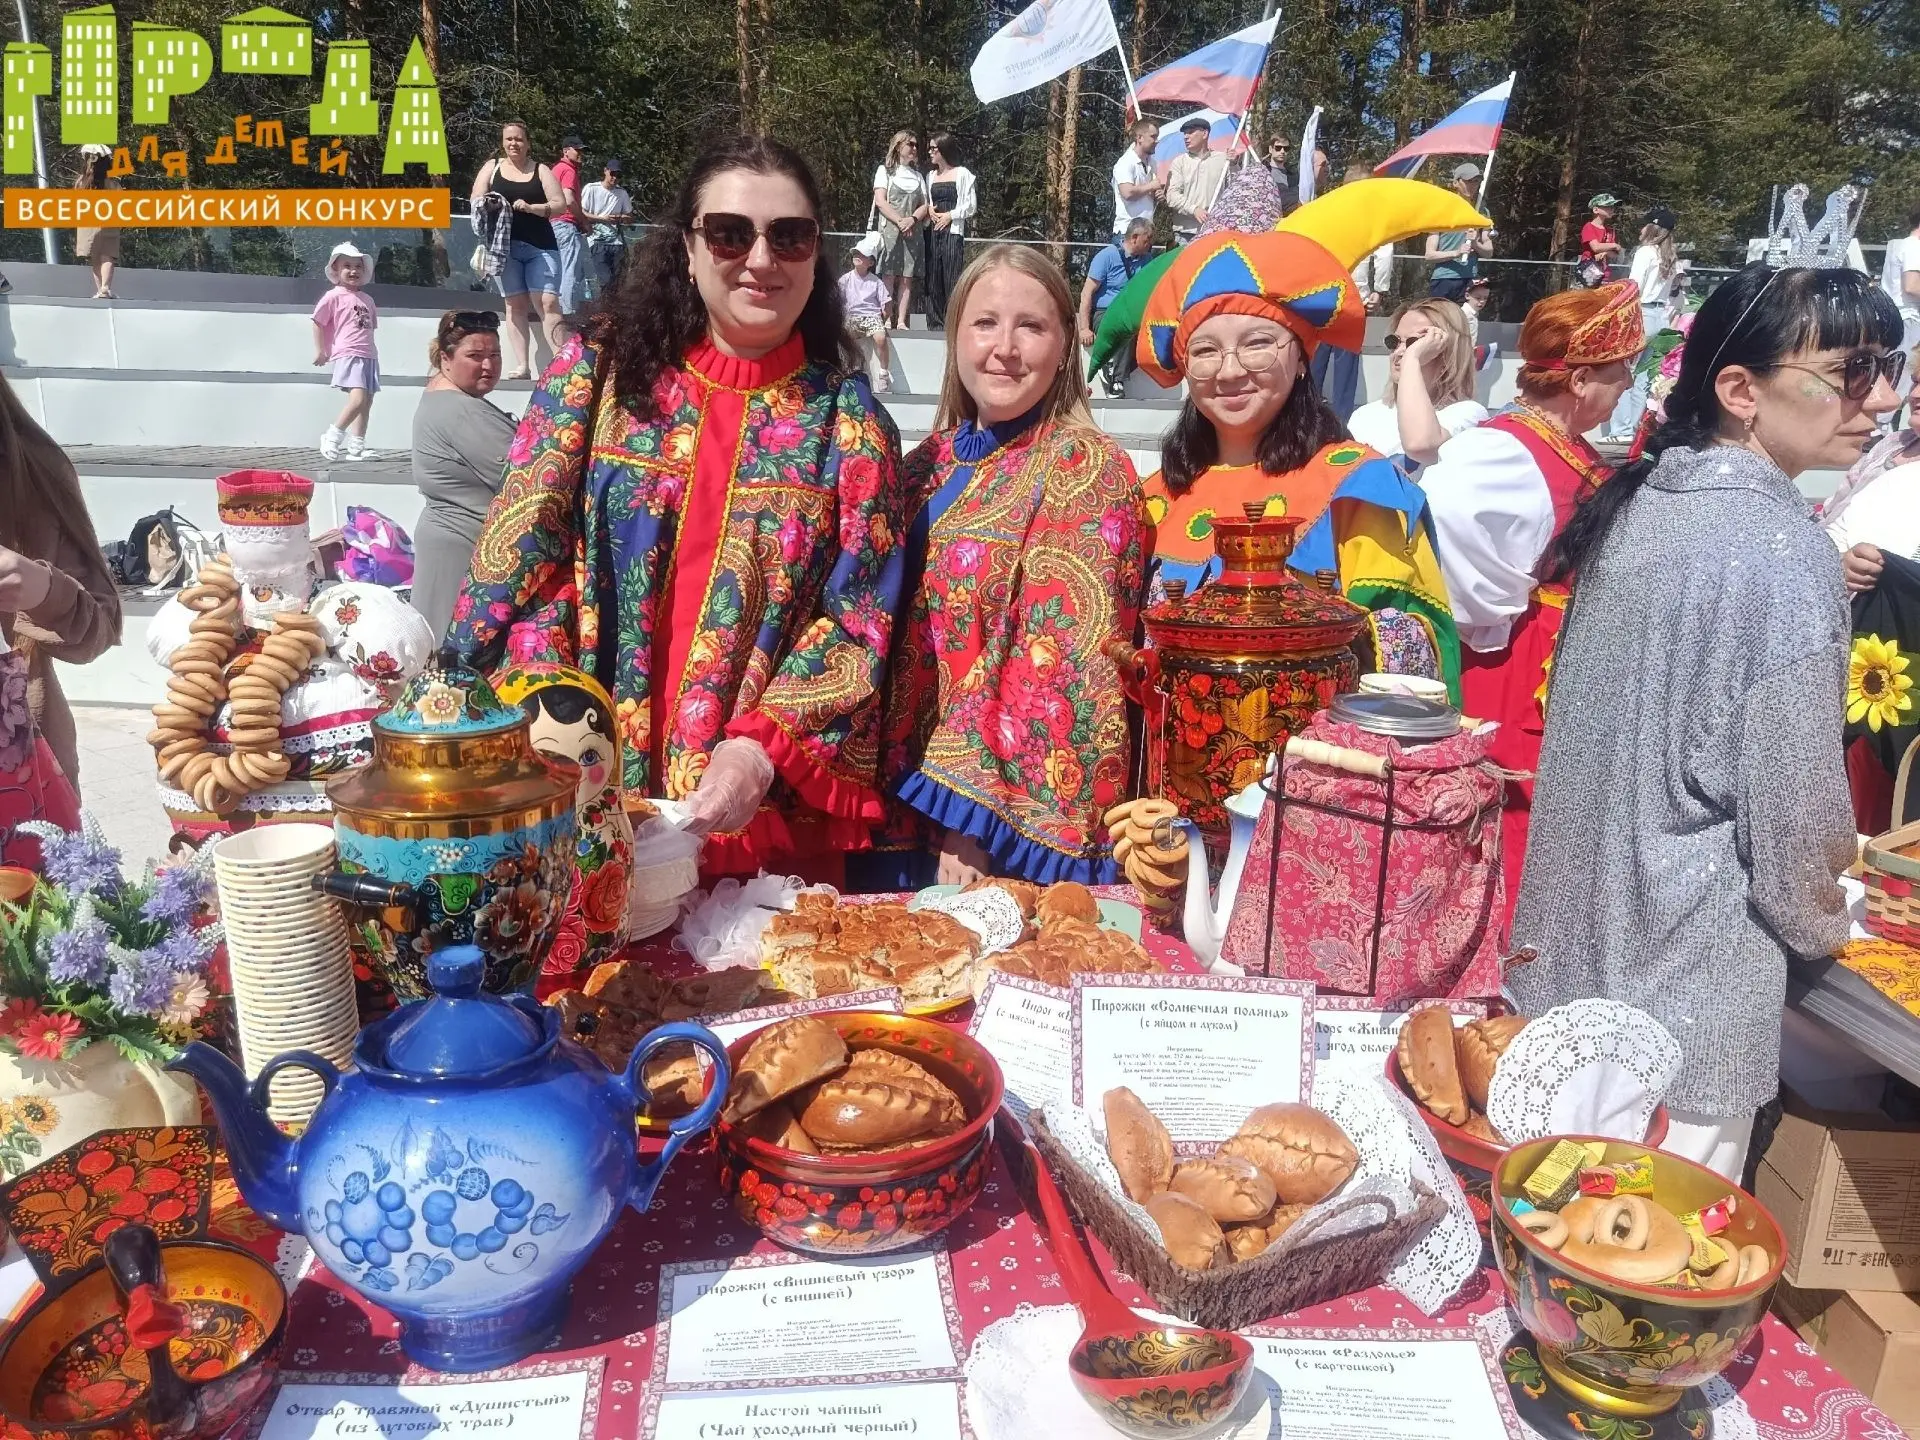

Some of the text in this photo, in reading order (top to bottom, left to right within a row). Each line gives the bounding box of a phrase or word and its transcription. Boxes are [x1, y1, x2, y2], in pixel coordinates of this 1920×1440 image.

[1021, 998, 1052, 1015] Пирог
[1091, 998, 1289, 1019] Пирожки «Солнечная поляна»
[1009, 1013, 1035, 1026] мясом
[1154, 1018, 1186, 1029] яйцом
[1200, 1020, 1238, 1032] луком)
[1327, 1043, 1355, 1053] ягод
[696, 1267, 915, 1297] Пирожки «Вишневый узор»
[784, 1286, 853, 1303] вишней)
[1267, 1344, 1416, 1360] Пирожки «Раздолье»
[1314, 1361, 1395, 1374] картошкой)
[286, 1394, 571, 1418] Отвар травяной «Душистый»
[745, 1403, 882, 1417] Настой чайный
[335, 1412, 515, 1436] (из луговых трав)
[699, 1417, 918, 1439] (Чай холодный черный)
